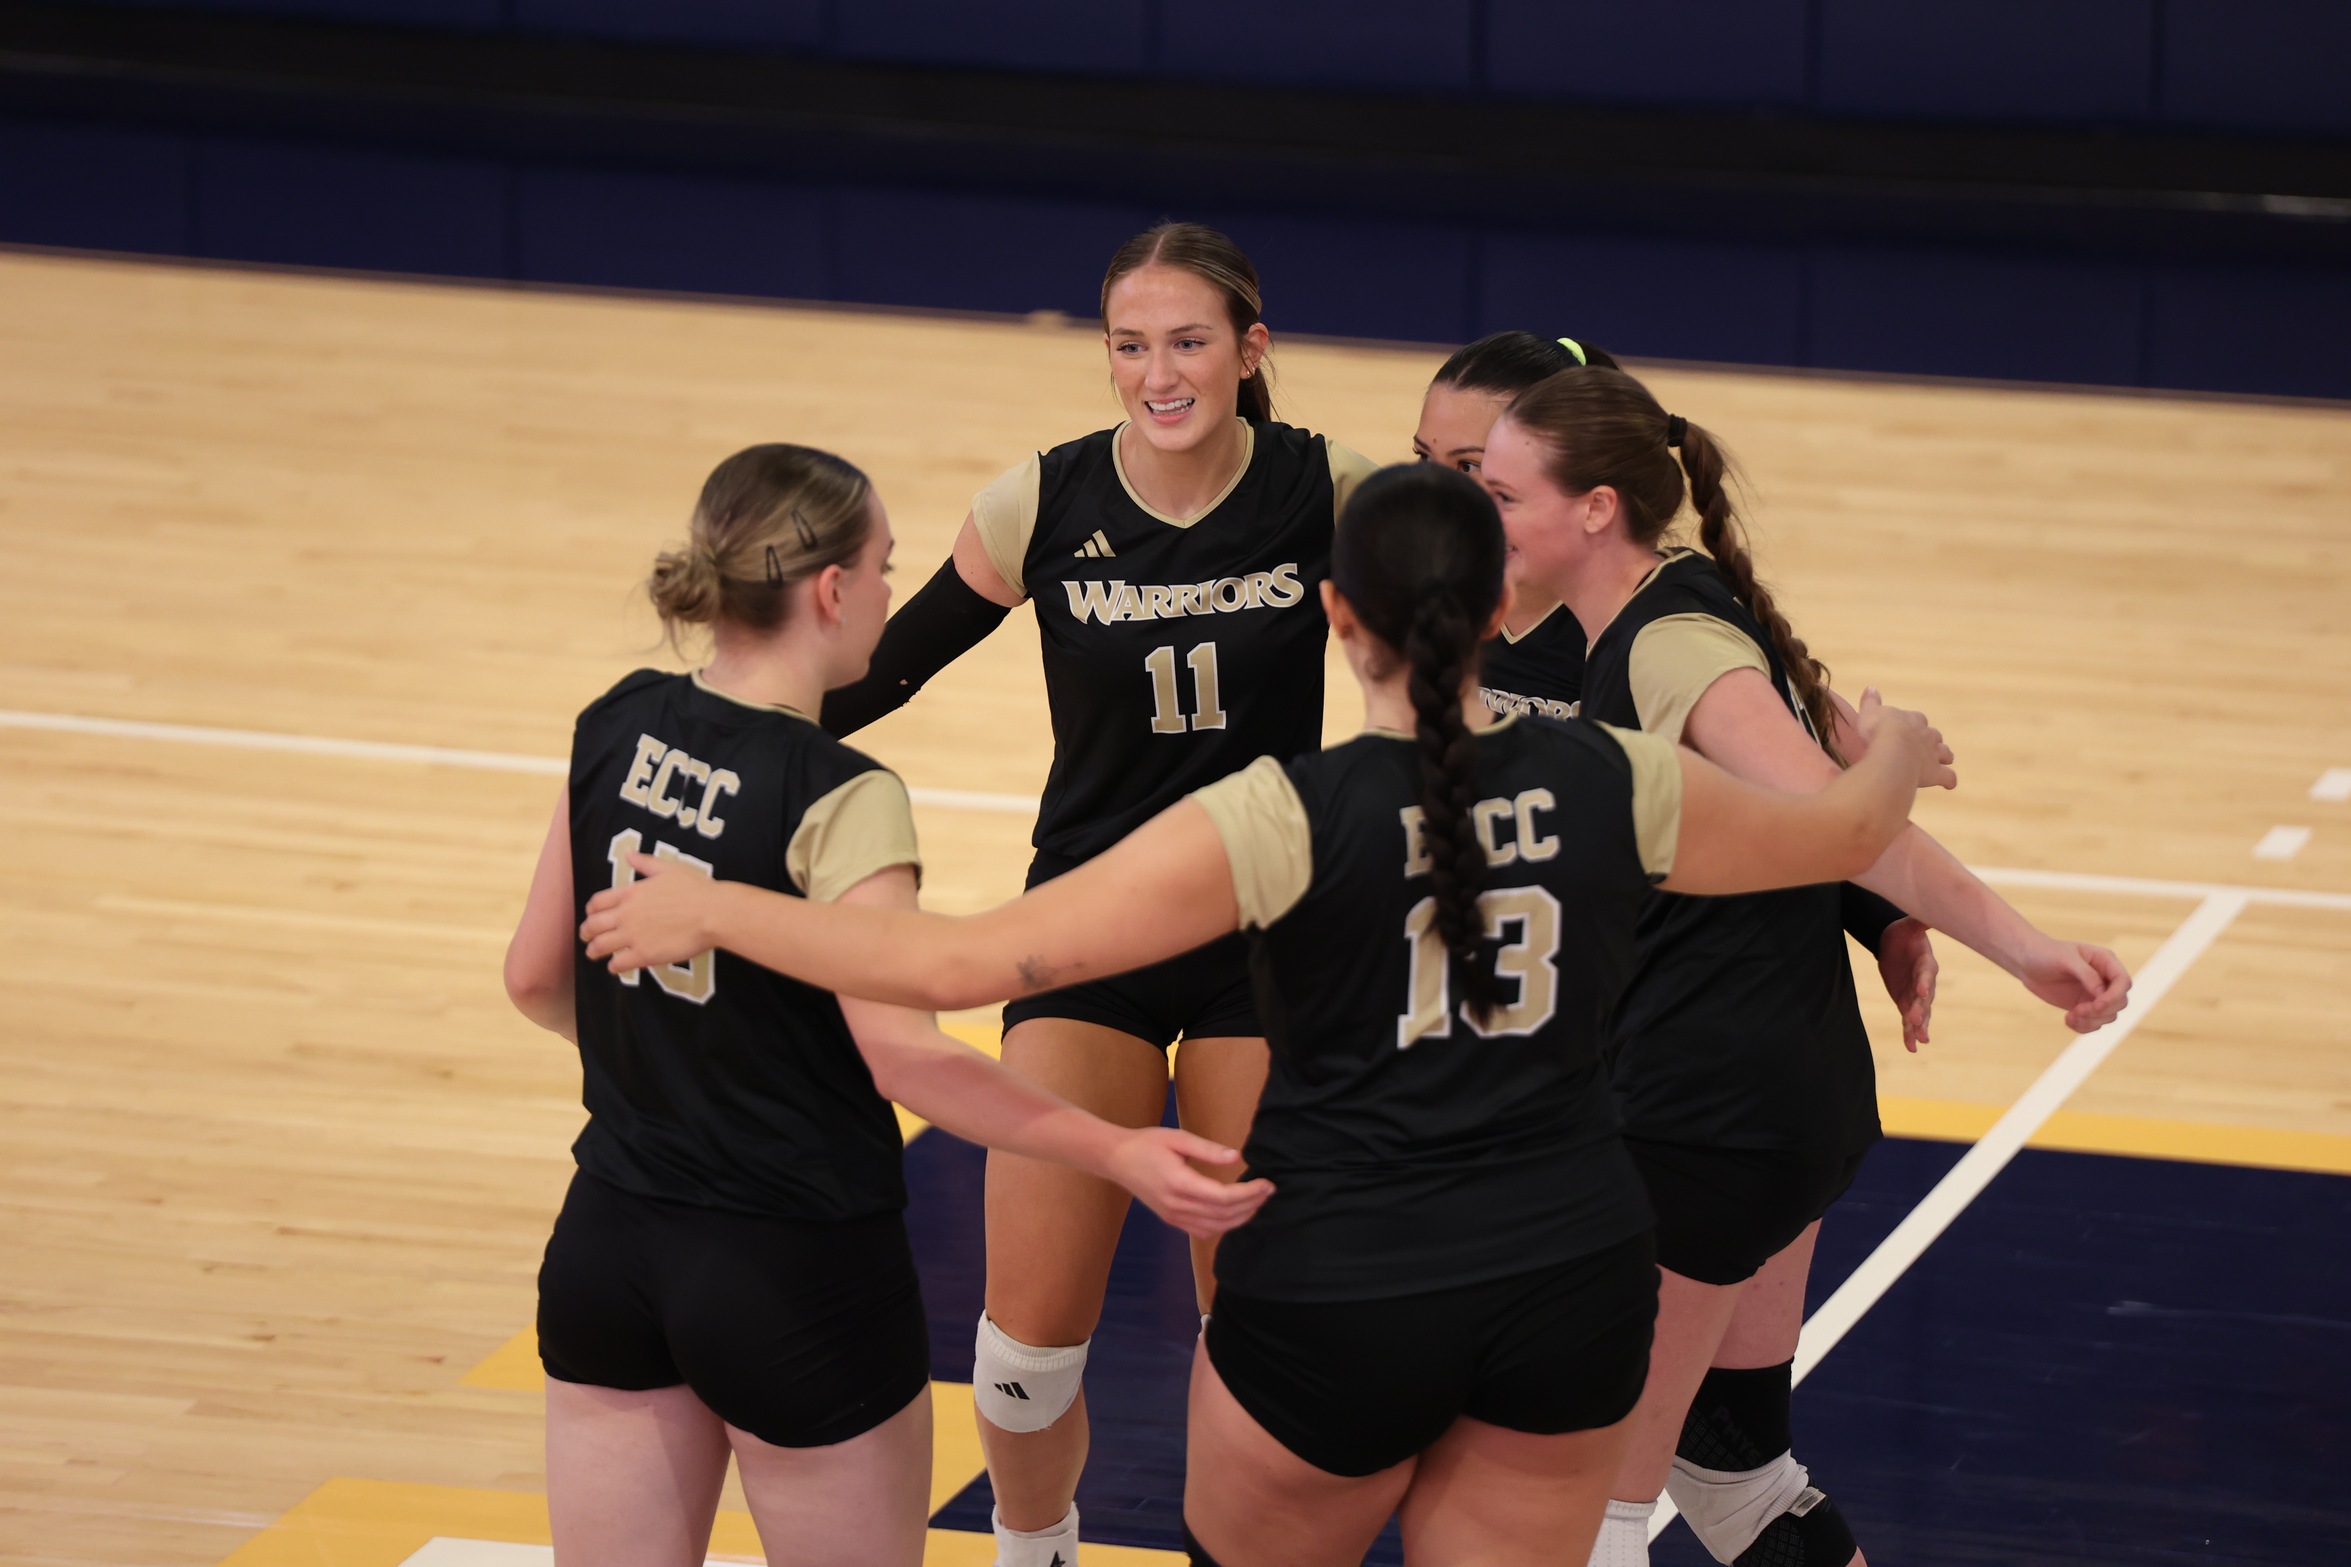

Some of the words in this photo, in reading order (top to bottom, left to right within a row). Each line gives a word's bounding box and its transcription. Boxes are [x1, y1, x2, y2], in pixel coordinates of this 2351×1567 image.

[1061, 563, 1304, 626] WARRIORS
[1145, 641, 1227, 734] 11
[1399, 787, 1560, 879] ECC
[1397, 884, 1562, 1050] 13
